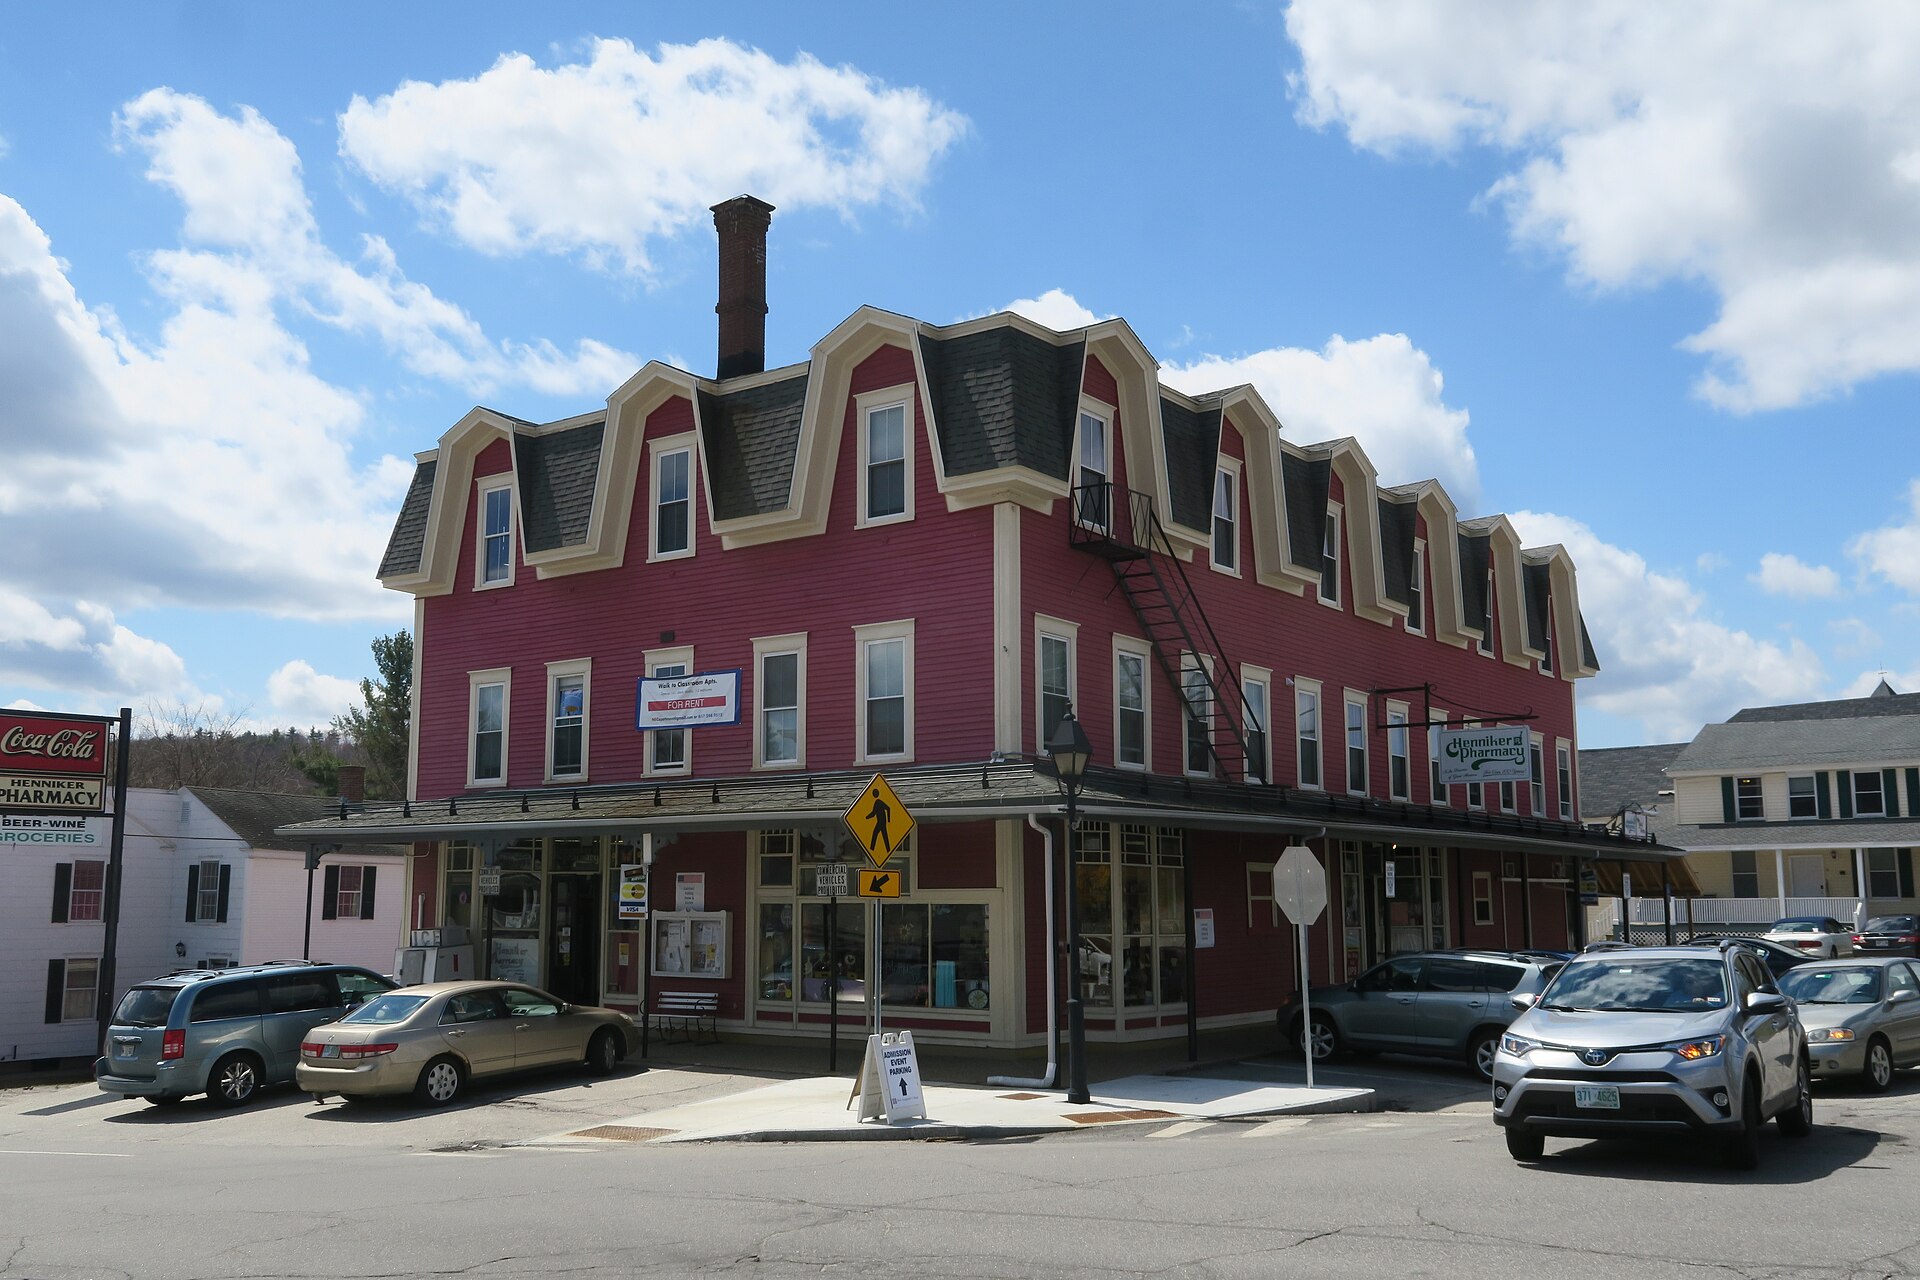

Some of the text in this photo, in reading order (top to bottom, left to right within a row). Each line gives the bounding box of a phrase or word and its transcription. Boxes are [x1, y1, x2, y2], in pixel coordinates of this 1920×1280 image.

[667, 699, 705, 709] FOR RENT
[0, 726, 98, 758] Coca-Cola
[1447, 736, 1513, 752] Henniker
[1460, 747, 1525, 765] Pharmacy
[11, 780, 85, 789] HENNIKER
[2, 819, 86, 828] BEER-WINE
[817, 865, 847, 874] COMMERCIAL
[819, 875, 845, 885] VEHICLES
[817, 885, 847, 895] PROHIBITED
[413, 931, 440, 946] ICE
[884, 1048, 911, 1058] ADMISSION
[890, 1057, 907, 1066] EVENT
[889, 1066, 912, 1075] PARKING
[1576, 1090, 1591, 1102] 371
